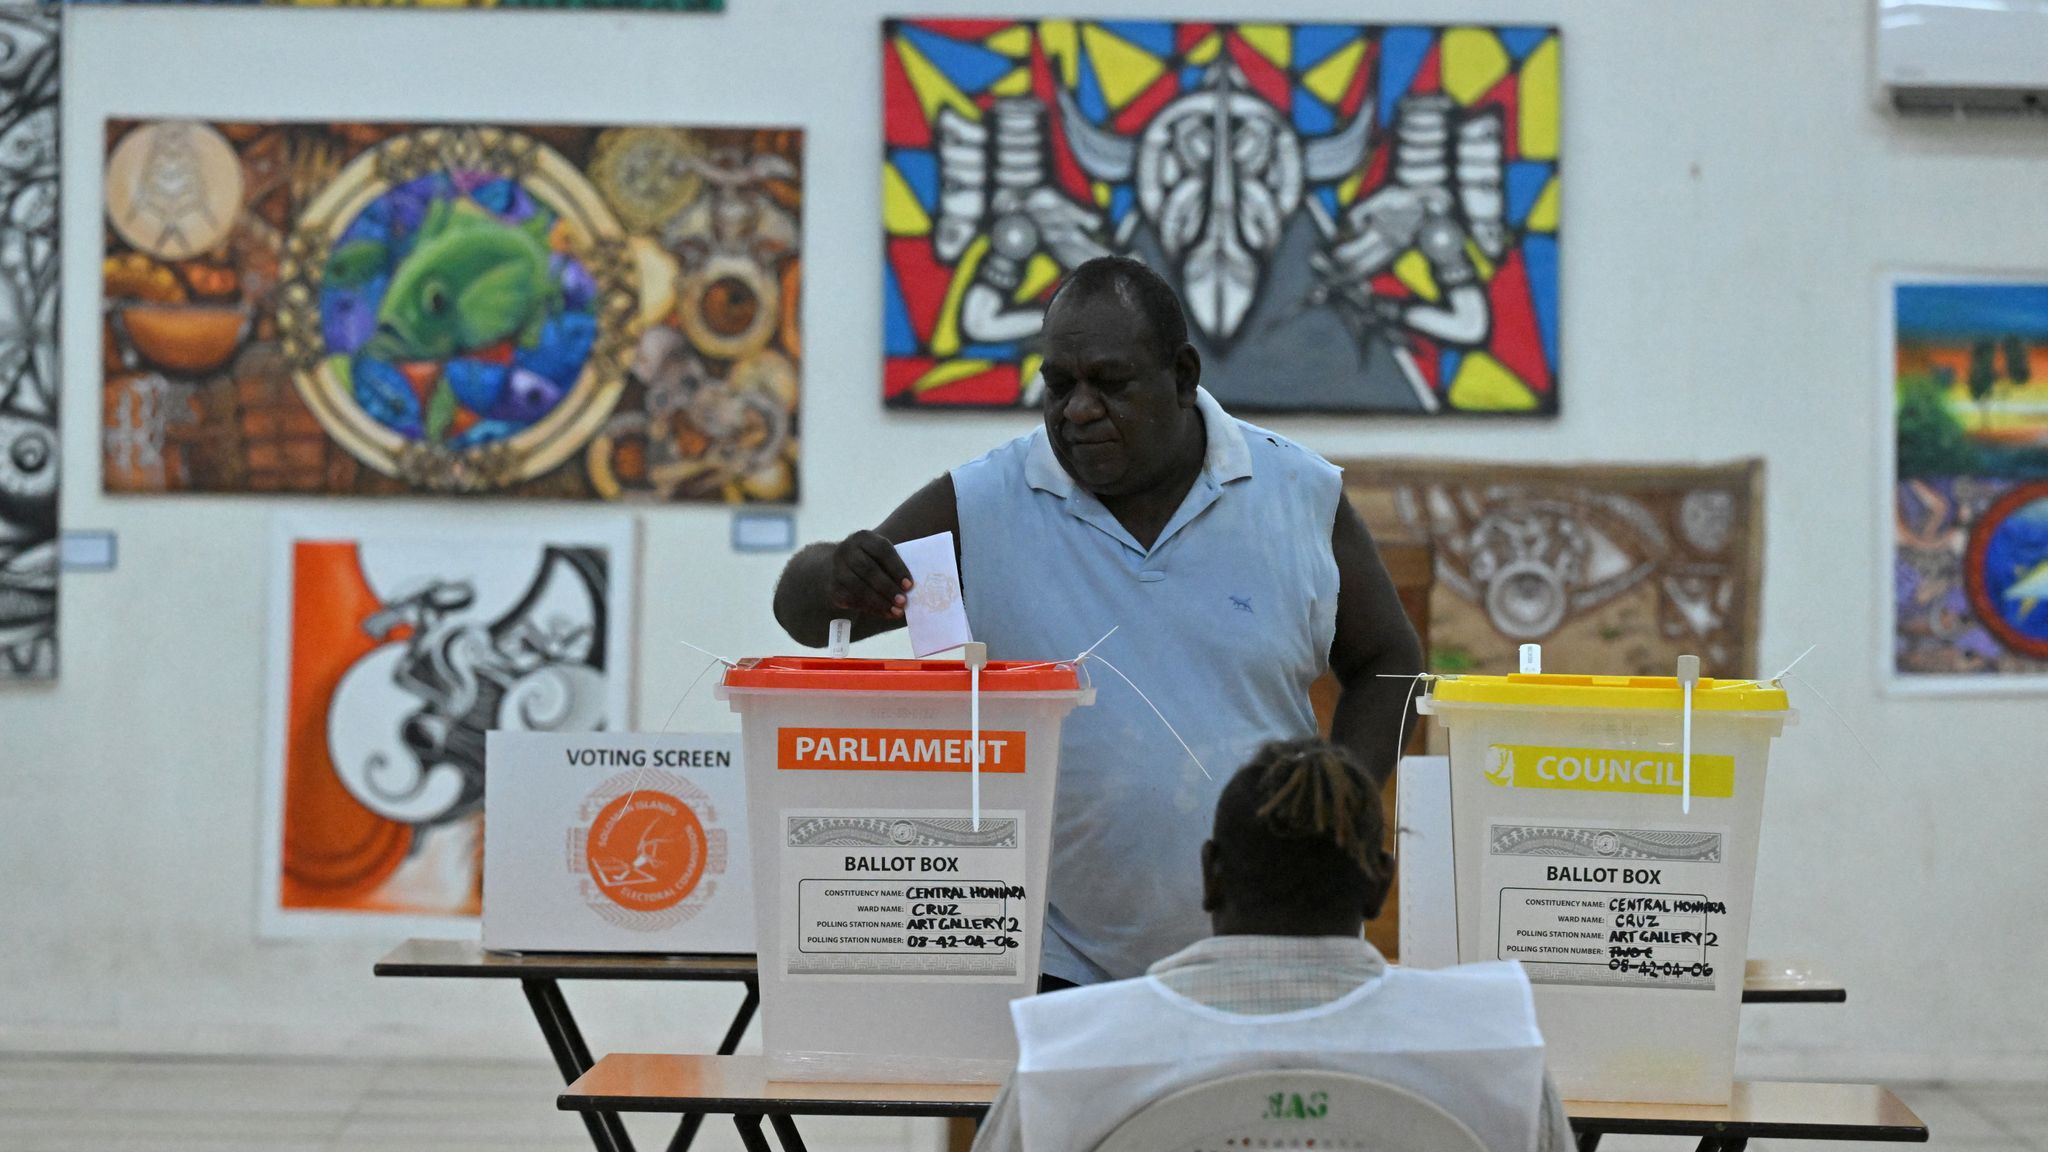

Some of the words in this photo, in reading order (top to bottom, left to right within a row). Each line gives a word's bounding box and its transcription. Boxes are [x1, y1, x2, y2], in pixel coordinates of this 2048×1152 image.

[795, 736, 1008, 764] PARLIAMENT
[567, 749, 647, 767] VOTING
[653, 750, 731, 768] SCREEN
[1536, 756, 1683, 786] COUNCIL
[844, 856, 916, 872] BALLOT
[920, 857, 959, 872] BOX
[1546, 866, 1618, 884] BALLOT
[1623, 869, 1662, 885] BOX
[824, 889, 880, 897] CONSTITUENCY
[906, 887, 968, 900] CENTRAL
[857, 905, 880, 913] WARD
[1525, 898, 1581, 907] CONSTITUENCY
[1609, 898, 1671, 912] CENTRAL
[912, 903, 962, 916] CRUZ
[1557, 915, 1580, 923] WARD
[1580, 916, 1605, 924] NAME:
[1615, 914, 1660, 927] CRUZ
[807, 936, 839, 944] POLLING
[839, 936, 870, 944] STATION
[1516, 930, 1548, 938] POLLING
[1549, 931, 1579, 939] STATION
[1506, 945, 1538, 953] POLLING
[1539, 946, 1569, 954] STATION
[1608, 958, 1714, 978] 08-42-04-06
